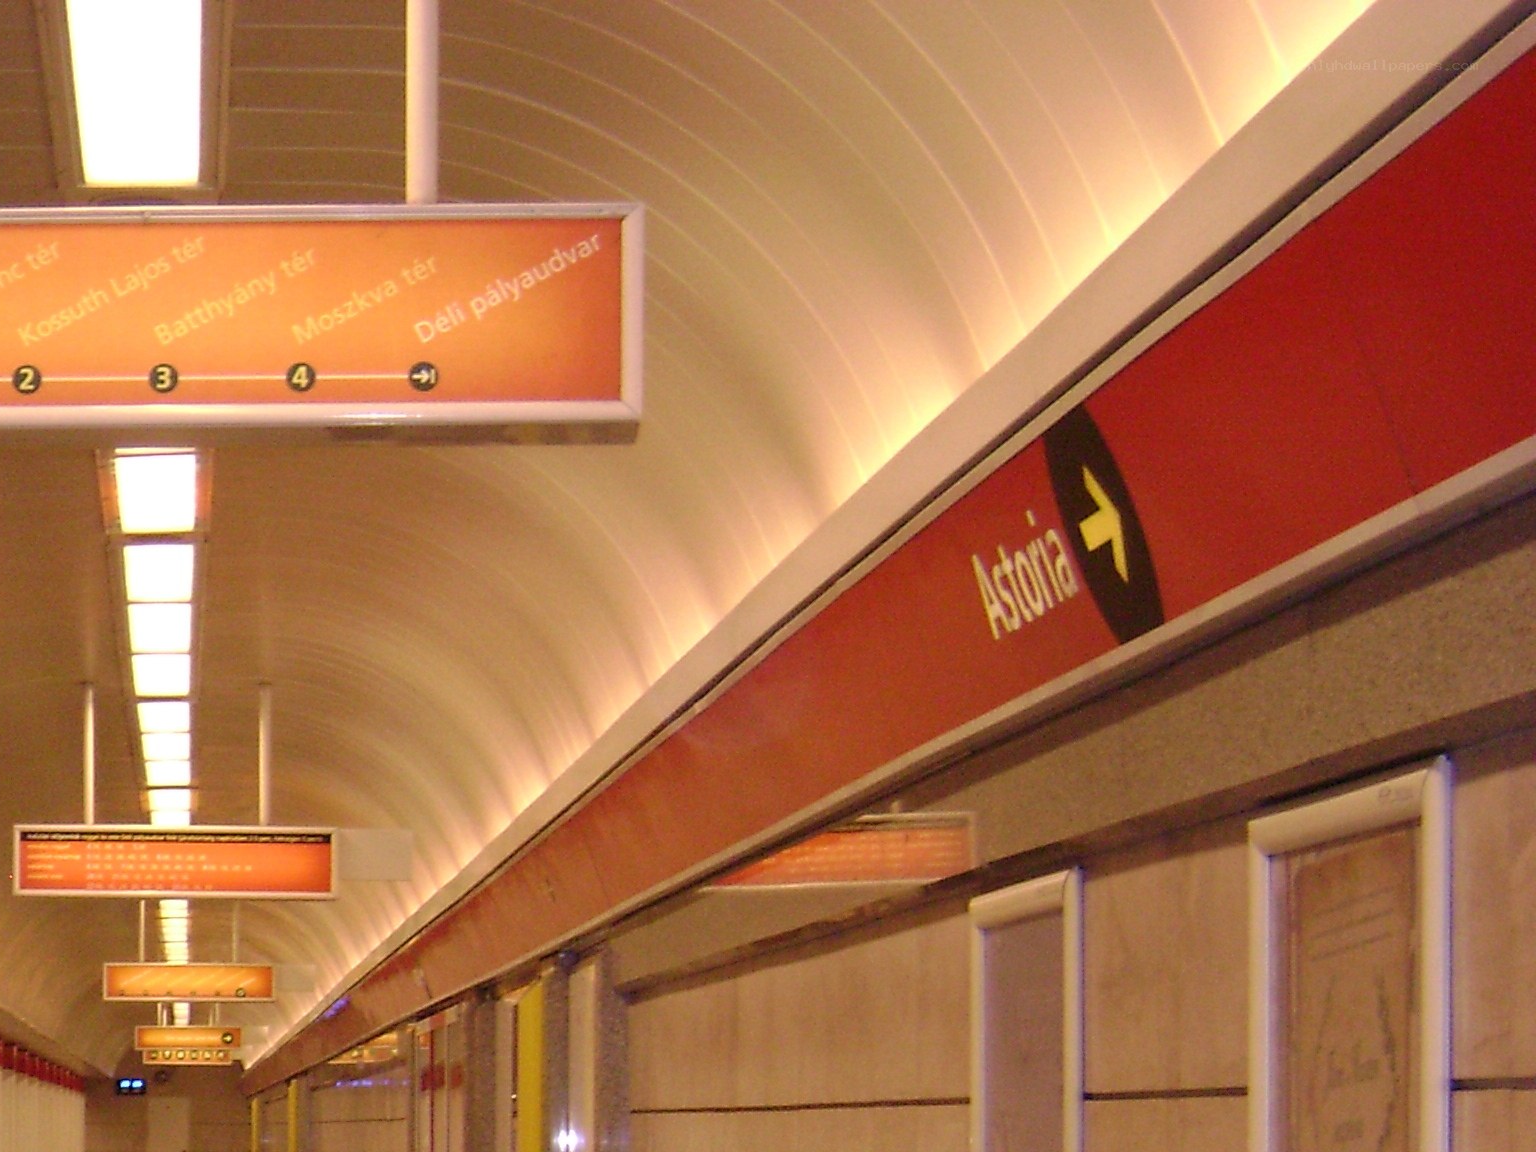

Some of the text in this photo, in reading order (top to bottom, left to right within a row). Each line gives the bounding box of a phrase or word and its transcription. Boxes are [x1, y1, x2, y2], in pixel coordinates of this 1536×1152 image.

[17, 235, 206, 347] Kossuth Lajos tér
[25, 241, 60, 271] tér
[153, 248, 316, 347] Batthyány tér
[290, 255, 438, 344] Moszkva tér
[414, 233, 603, 344] Déli pályaudvar
[17, 368, 36, 391] 2
[155, 367, 172, 389] 3
[291, 366, 309, 388] 4
[971, 509, 1080, 641] Astoria
